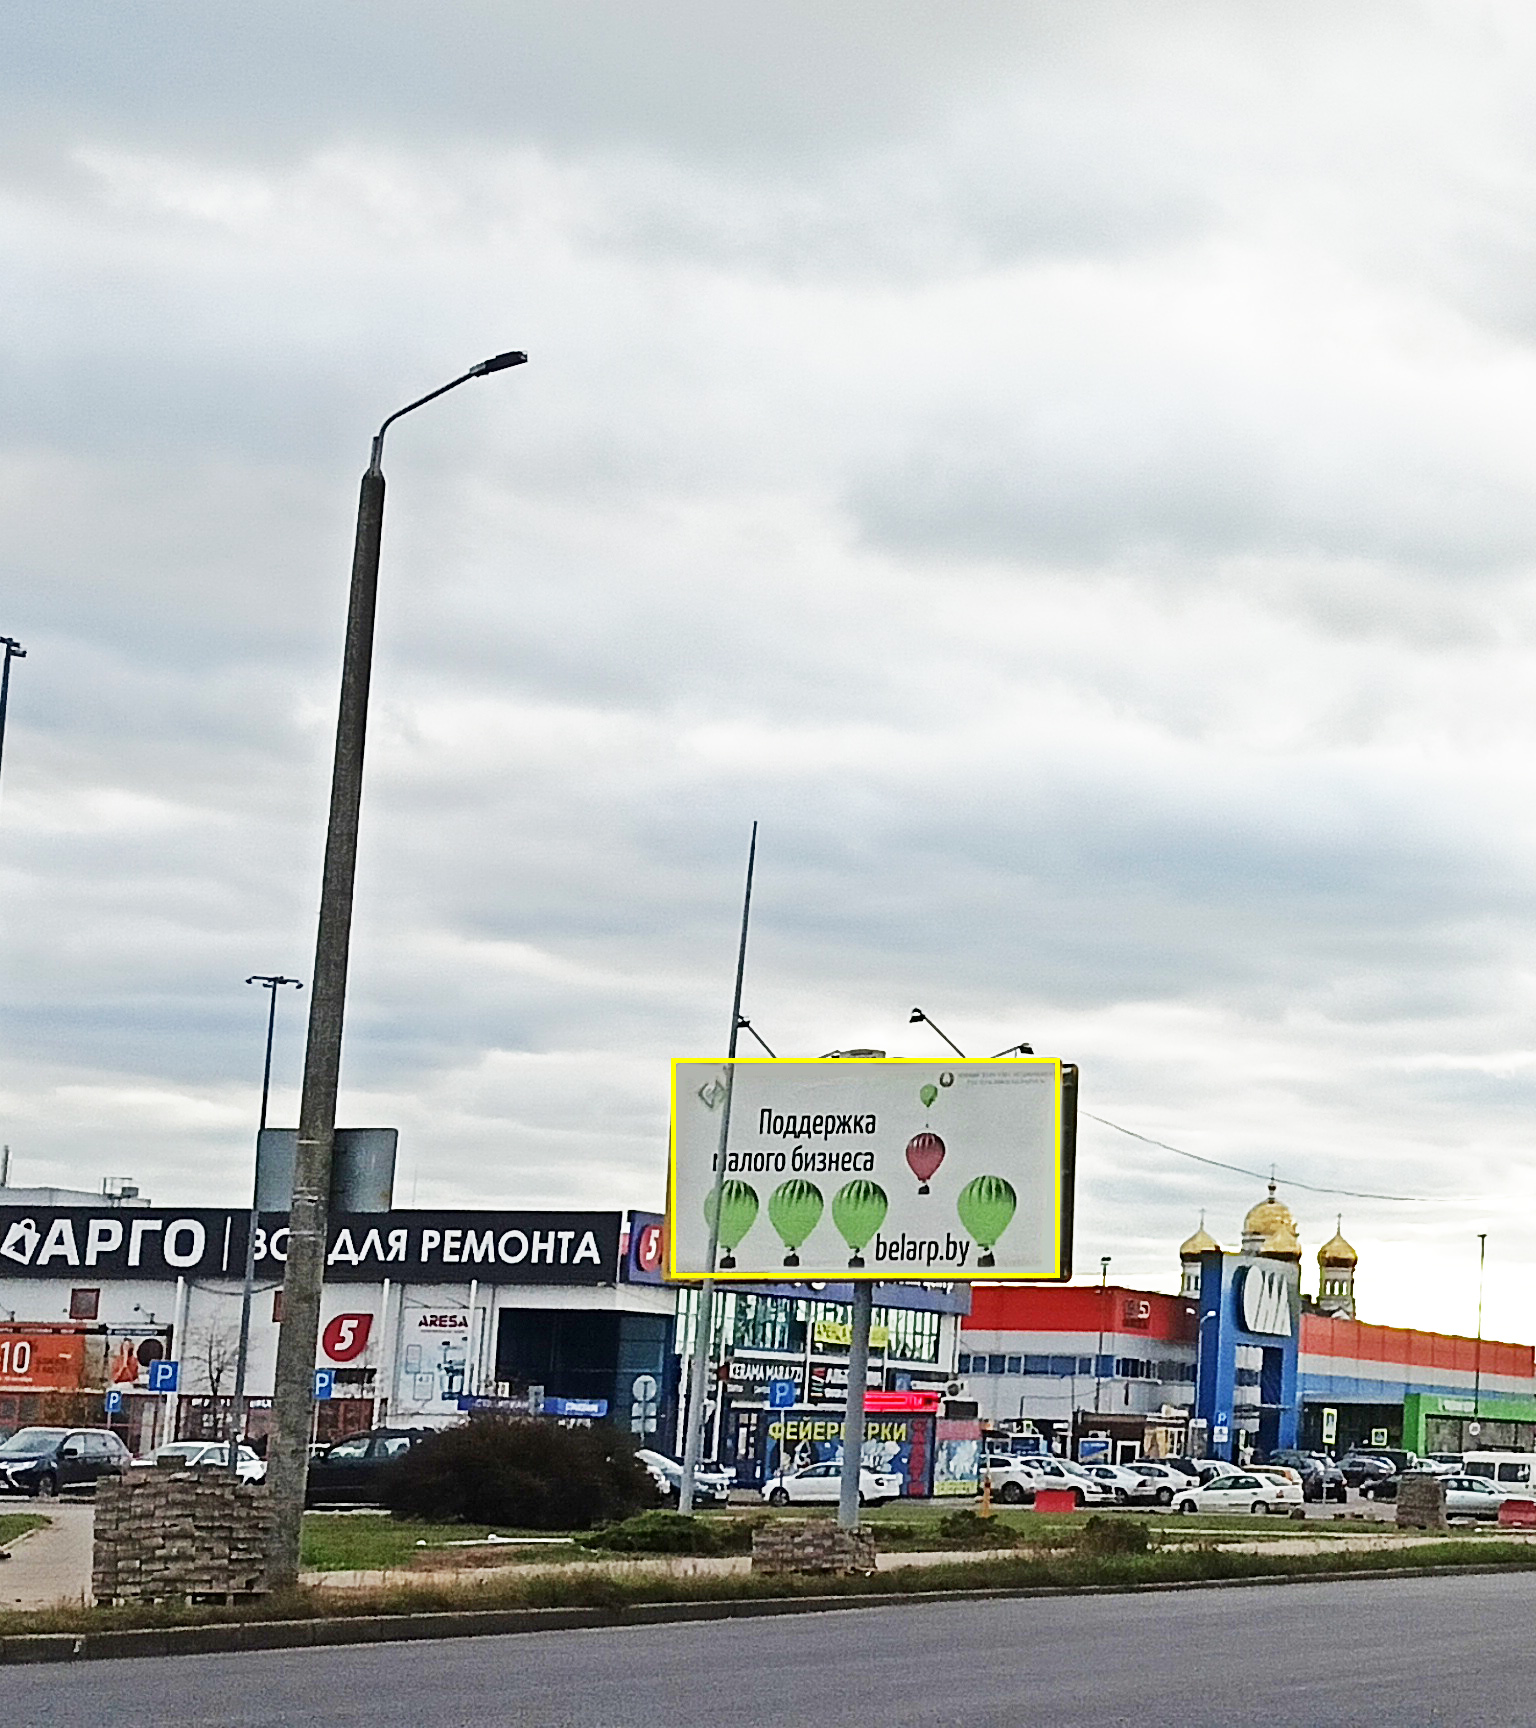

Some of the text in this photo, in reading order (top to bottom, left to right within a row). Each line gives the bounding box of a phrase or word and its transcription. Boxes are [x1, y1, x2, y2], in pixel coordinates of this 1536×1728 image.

[759, 1108, 876, 1141] Поддержка
[791, 1144, 875, 1172] бизнеса
[35, 1218, 206, 1268] АРГО
[327, 1228, 409, 1266] ДЛЯ
[419, 1229, 602, 1265] РЕМОНТА
[875, 1232, 970, 1267] belarp.by
[334, 1319, 359, 1351] 5
[418, 1314, 469, 1328] ARESA
[768, 1416, 907, 1441] ФЕЙЕРРКИ
